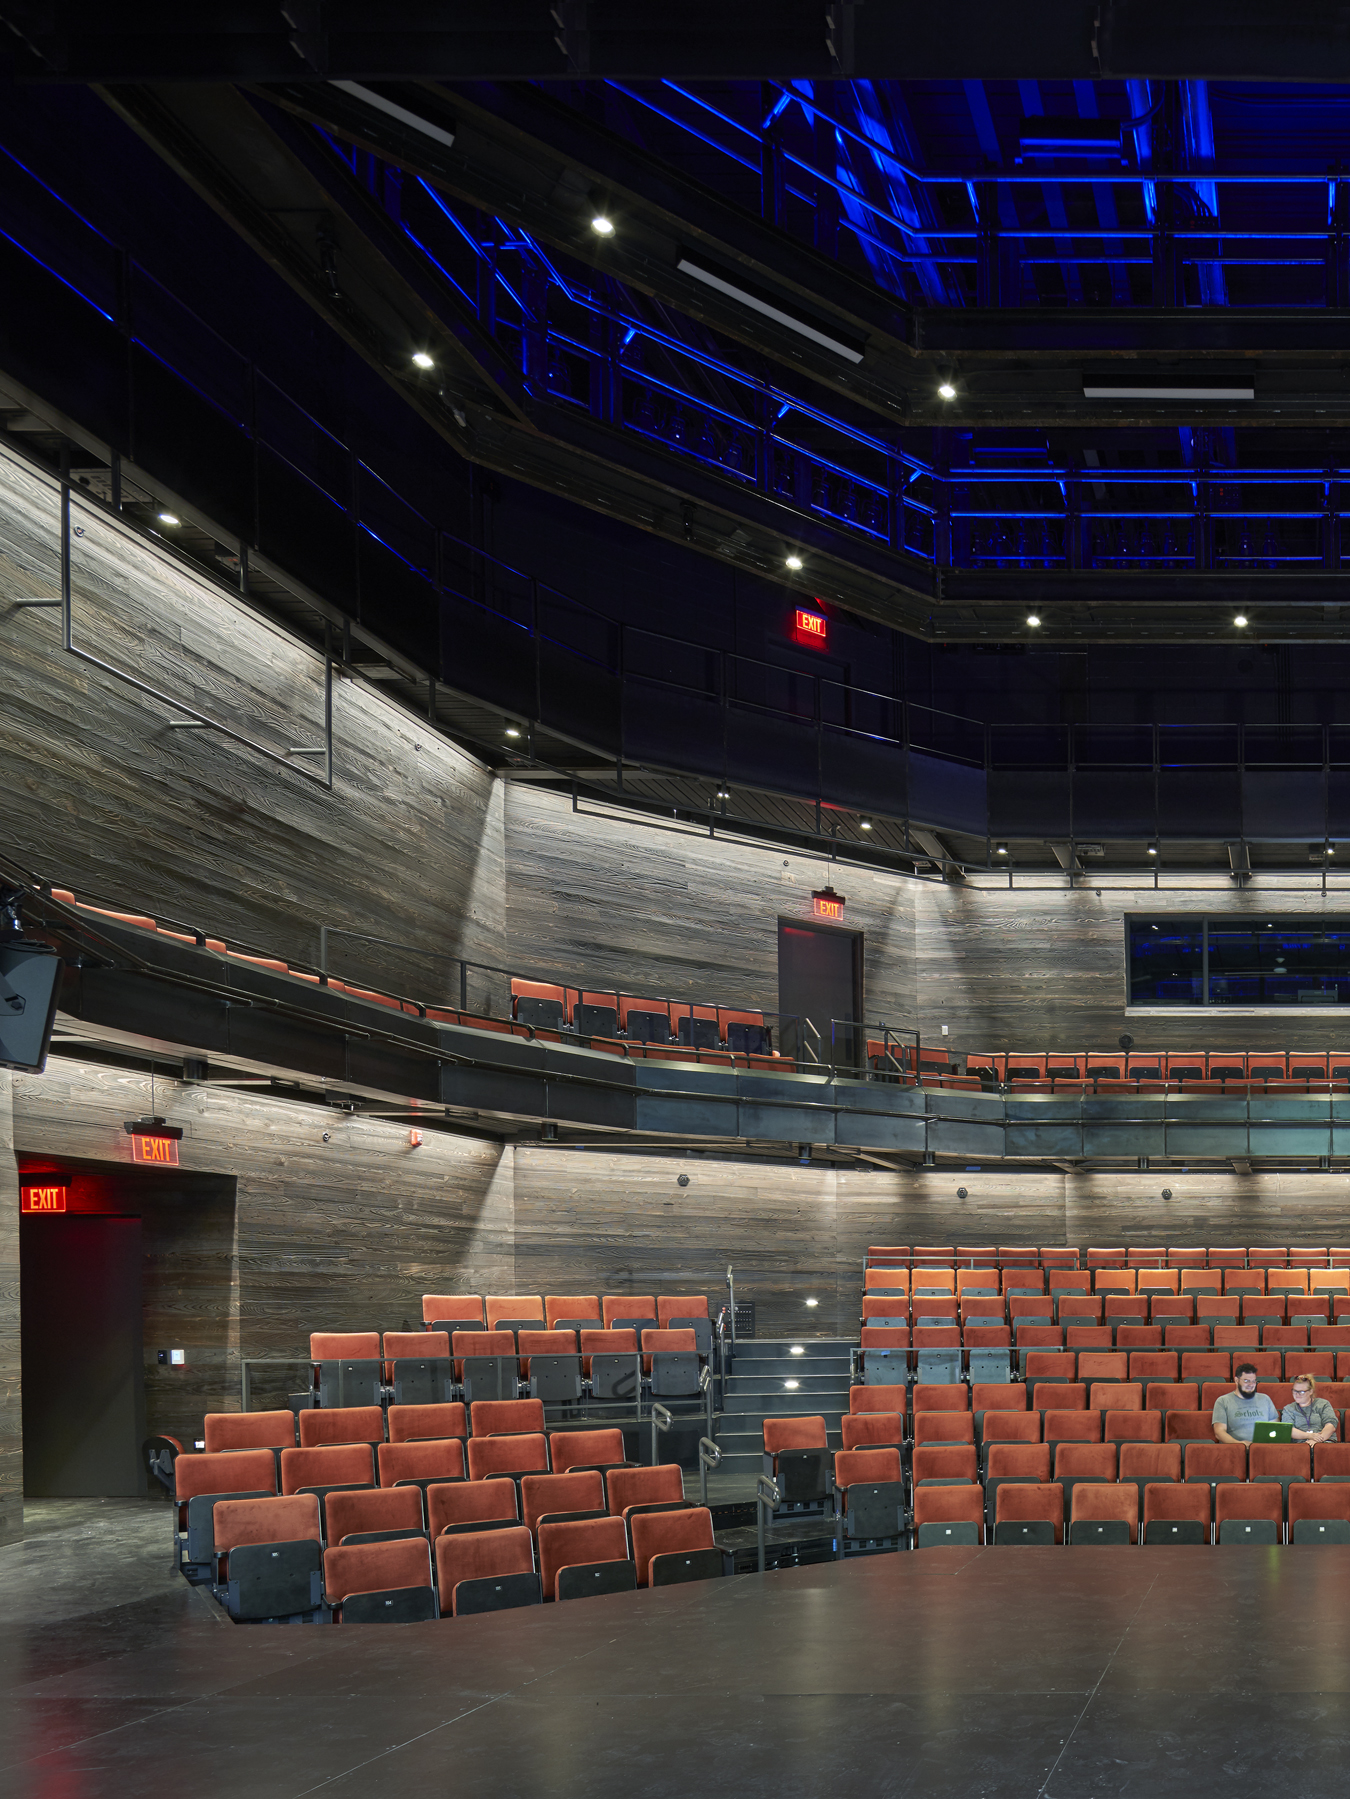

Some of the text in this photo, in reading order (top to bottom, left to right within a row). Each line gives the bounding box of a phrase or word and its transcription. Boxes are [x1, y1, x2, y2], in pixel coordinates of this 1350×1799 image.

[802, 615, 822, 633] EXIT
[820, 900, 839, 917] EXIT
[142, 1137, 170, 1161] EXIT
[30, 1189, 59, 1209] EXIT
